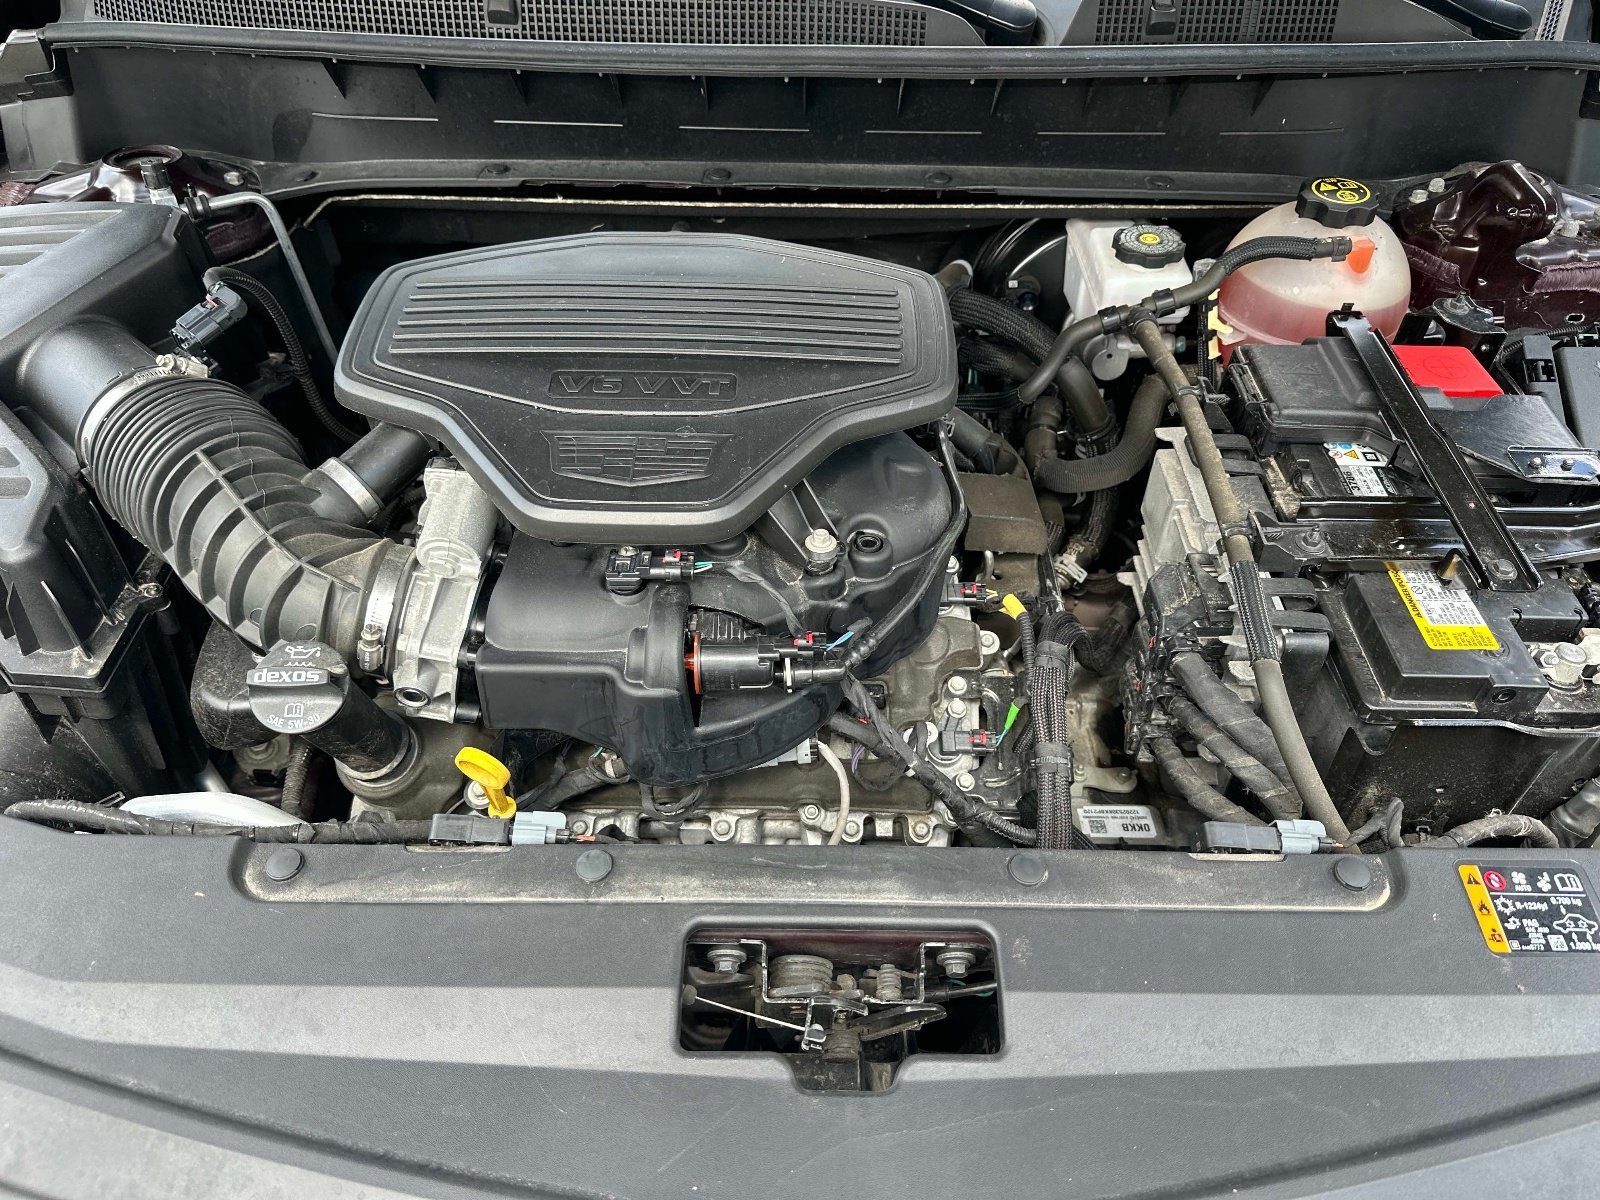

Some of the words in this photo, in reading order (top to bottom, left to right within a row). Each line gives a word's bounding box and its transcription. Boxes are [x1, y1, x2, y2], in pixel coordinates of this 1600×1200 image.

[558, 375, 624, 394] V6
[634, 376, 731, 395] VVT
[253, 668, 322, 683] dexos
[267, 714, 285, 728] SAE
[288, 713, 321, 730] 5W-30
[1571, 897, 1583, 907] kg
